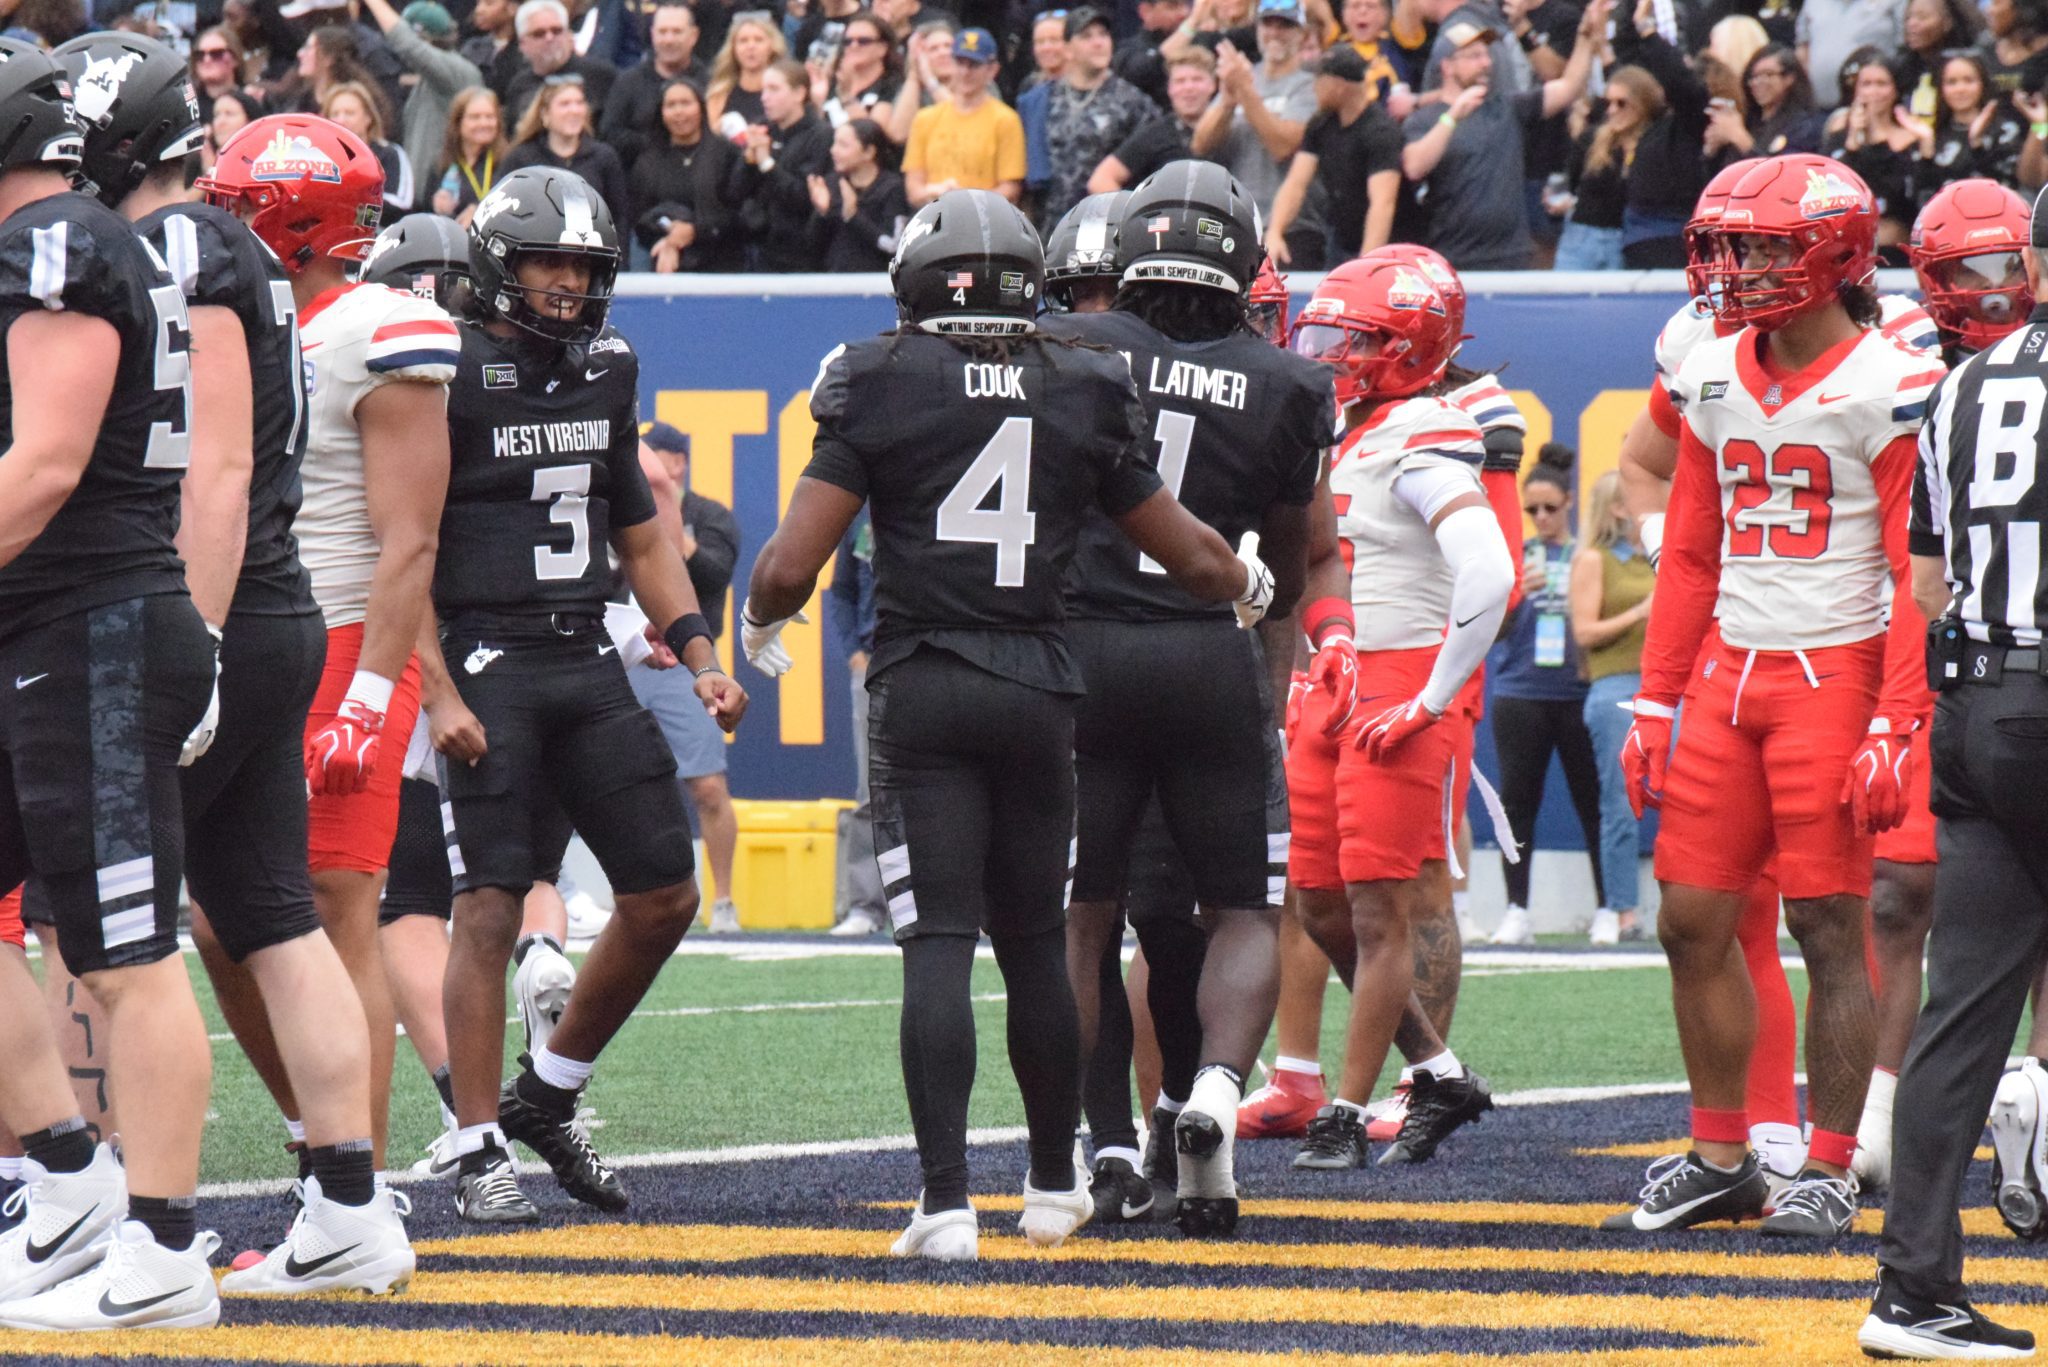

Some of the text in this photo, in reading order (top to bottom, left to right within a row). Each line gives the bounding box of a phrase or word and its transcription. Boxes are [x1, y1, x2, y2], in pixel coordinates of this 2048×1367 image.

[1155, 231, 1161, 250] 1
[1167, 266, 1198, 279] SEMPER
[953, 287, 966, 306] 4
[974, 322, 1005, 333] SEMPER
[2026, 331, 2046, 348] S
[964, 363, 1026, 400] COOK
[1150, 356, 1247, 410] LATIMER
[1762, 384, 1782, 405] A
[493, 420, 609, 458] WEST VIRGINIA
[1969, 376, 2047, 509] B
[936, 417, 1036, 587] 4
[1139, 409, 1196, 574] 1
[1722, 438, 1834, 559] 23
[530, 463, 591, 580] 3
[1974, 655, 1988, 677] S
